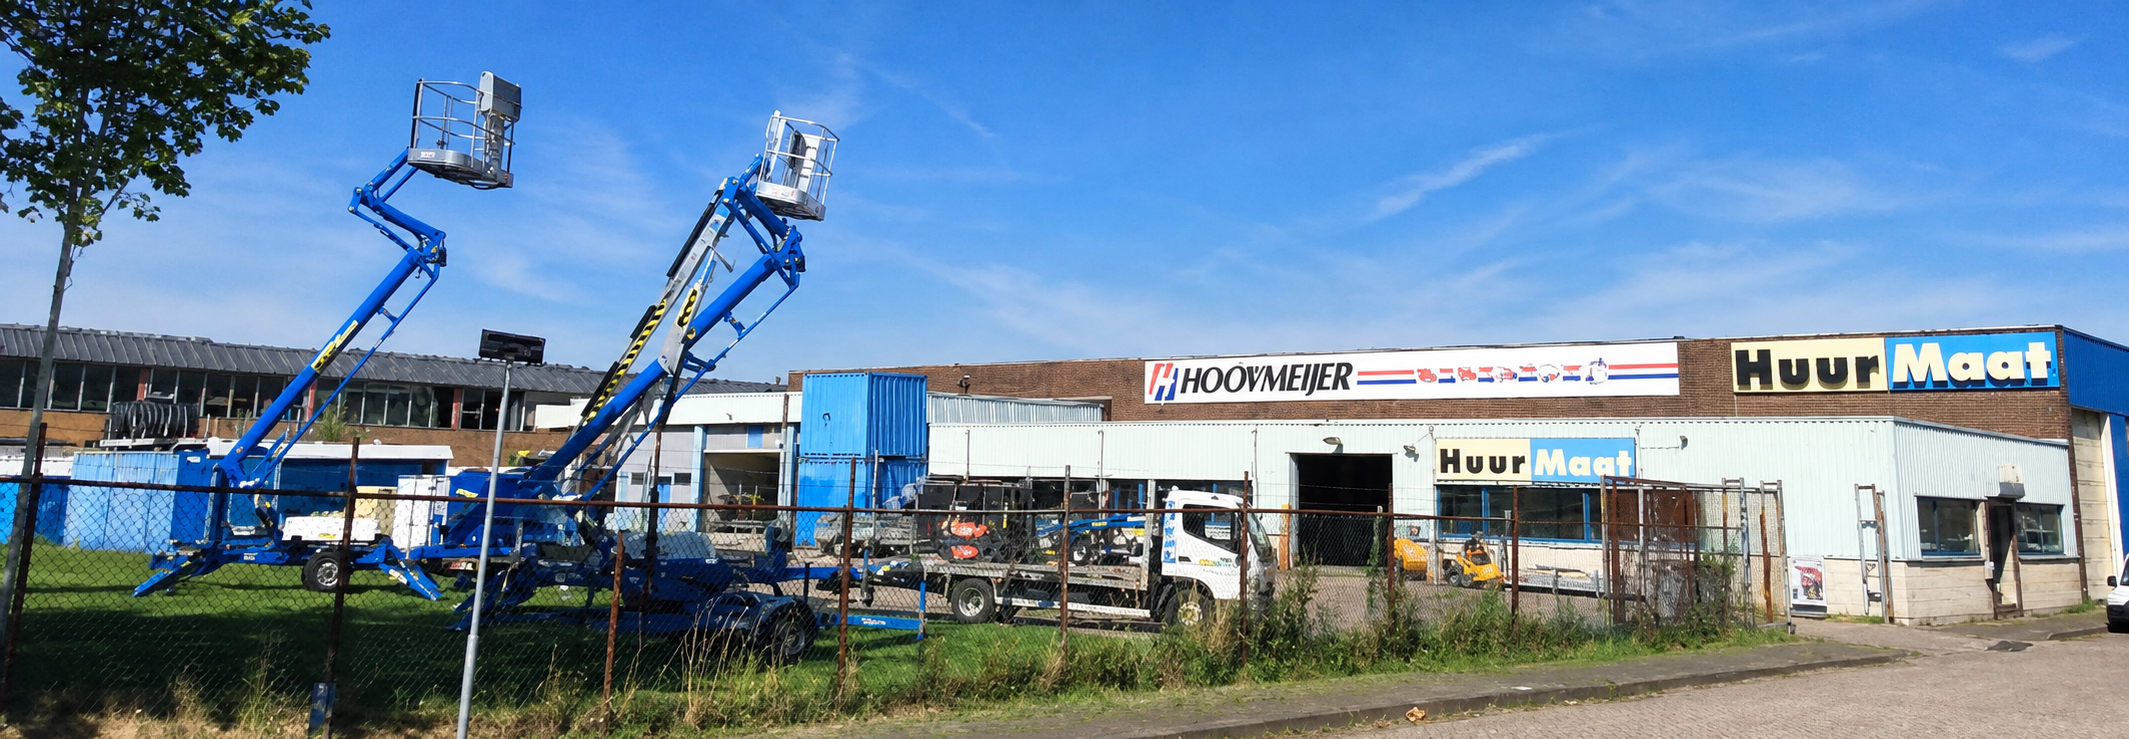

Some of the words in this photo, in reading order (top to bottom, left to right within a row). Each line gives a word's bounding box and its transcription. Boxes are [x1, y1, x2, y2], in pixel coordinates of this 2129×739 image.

[1735, 349, 1879, 388] Huur
[1892, 341, 2052, 386] Maat
[1439, 448, 1526, 474] Huur
[1534, 448, 1632, 477] Maat
